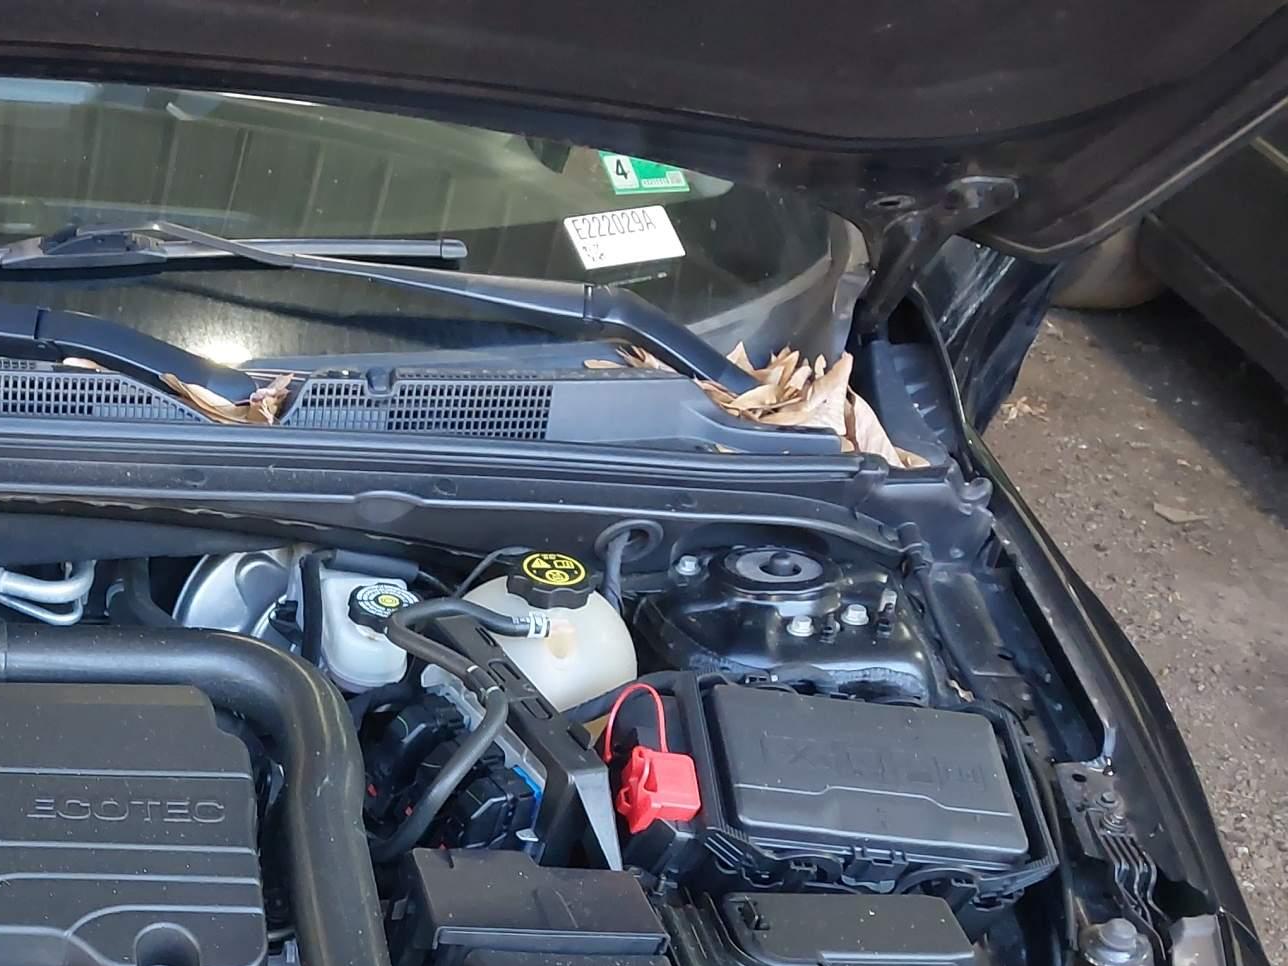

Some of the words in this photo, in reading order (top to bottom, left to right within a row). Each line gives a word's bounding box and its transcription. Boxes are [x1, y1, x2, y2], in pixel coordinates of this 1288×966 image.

[615, 159, 628, 180] 4
[572, 209, 657, 240] E222029A
[26, 799, 226, 823] ECOTEC
